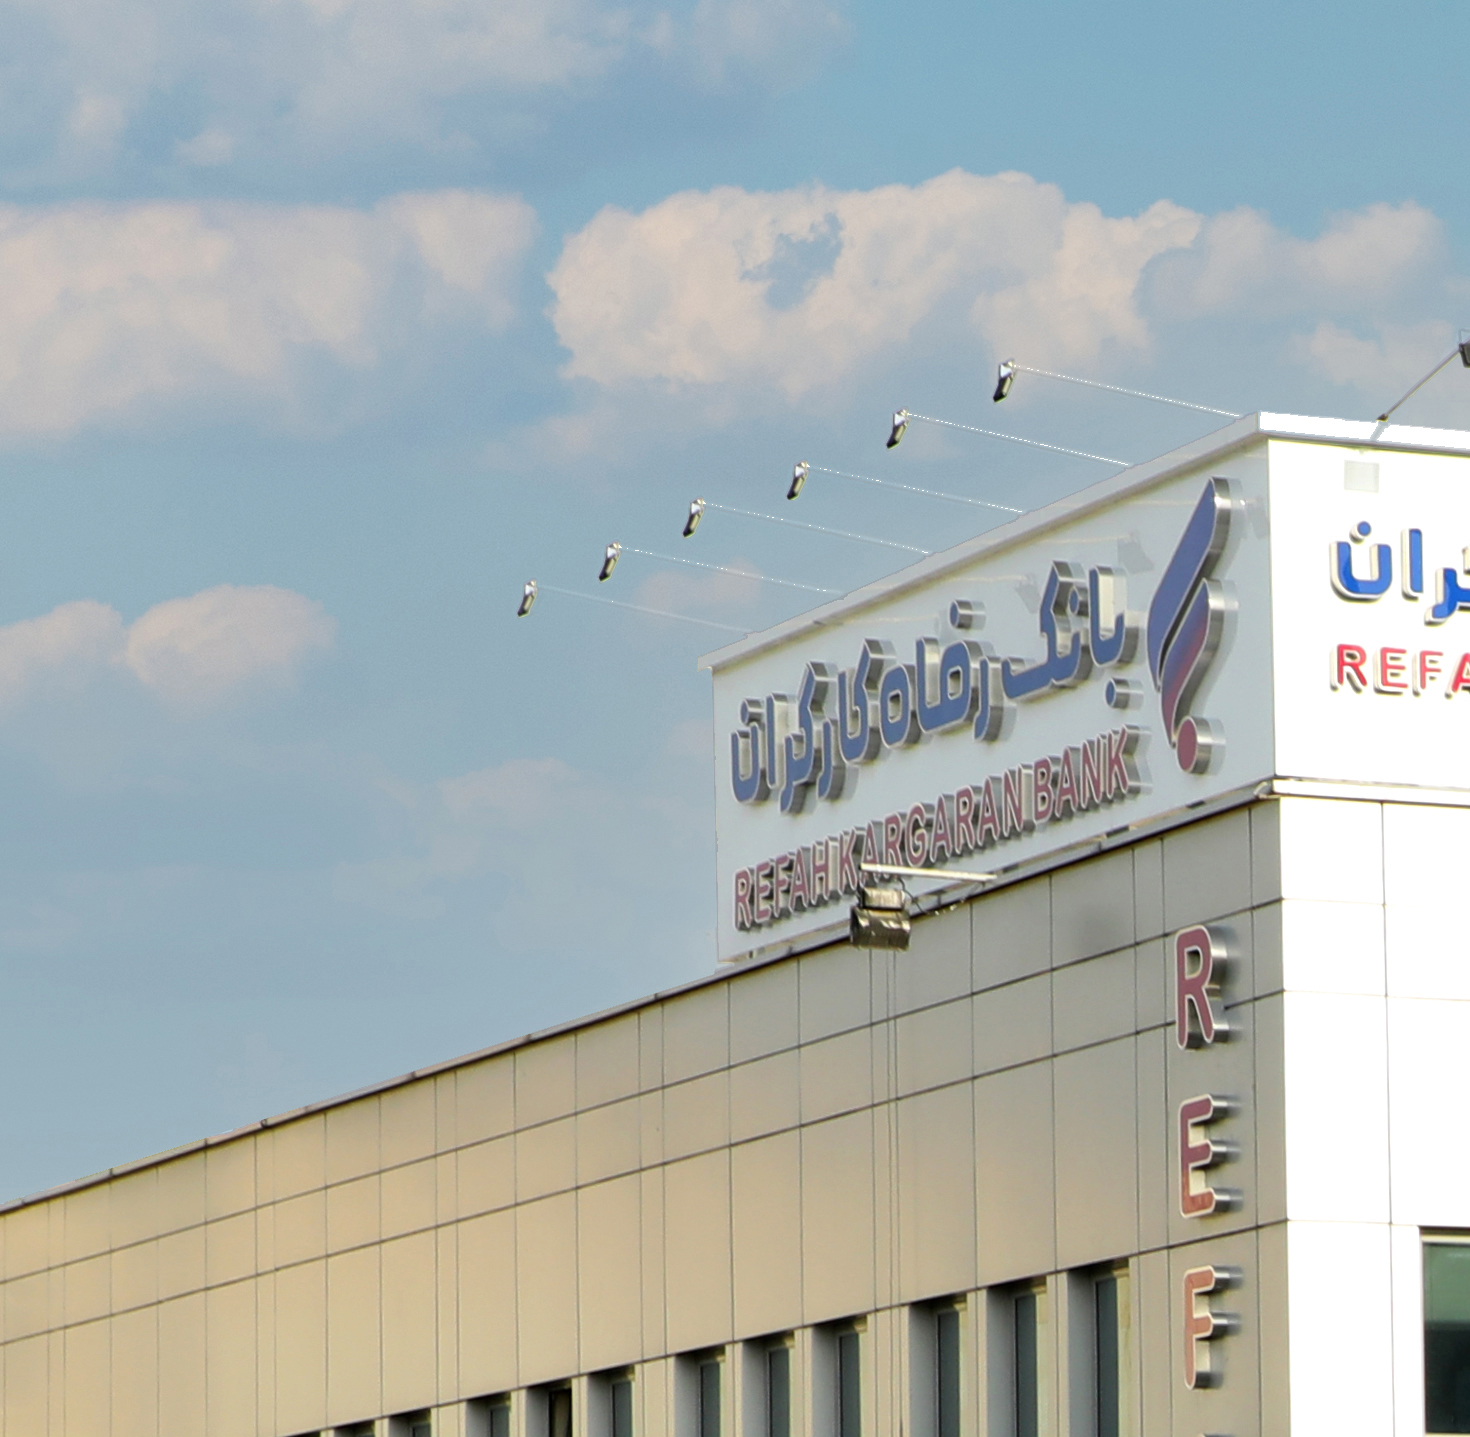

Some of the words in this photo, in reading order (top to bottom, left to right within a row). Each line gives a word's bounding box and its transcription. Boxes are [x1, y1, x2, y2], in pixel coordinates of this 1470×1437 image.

[879, 600, 996, 748] رفاه
[1001, 560, 1133, 710] بانک
[730, 638, 888, 813] کارگران
[734, 836, 835, 931] REFAH
[838, 764, 1028, 897] KARGARAN
[1033, 726, 1135, 824] BANK
